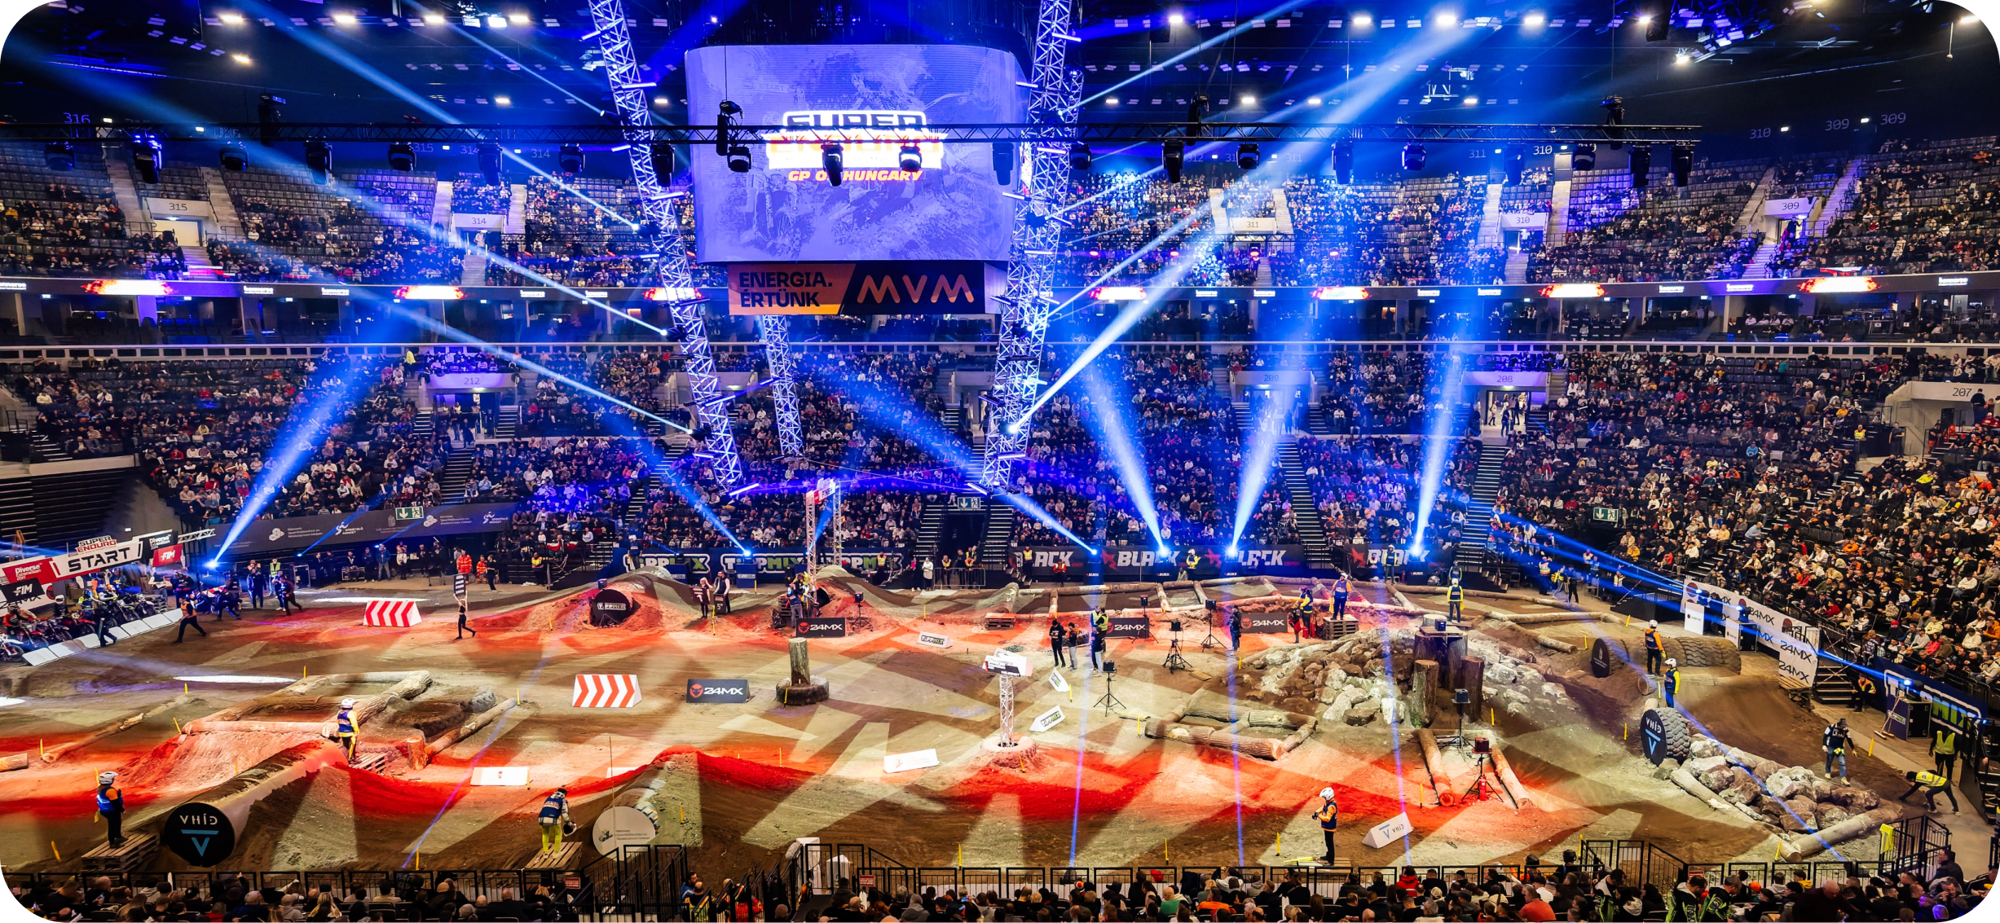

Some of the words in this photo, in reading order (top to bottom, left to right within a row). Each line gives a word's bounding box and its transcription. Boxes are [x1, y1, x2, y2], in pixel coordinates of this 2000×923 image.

[1825, 118, 1849, 131] 309
[1880, 112, 1906, 126] 309
[1750, 127, 1771, 139] 310
[1469, 149, 1486, 158] 311
[1533, 145, 1553, 156] 310
[788, 170, 811, 181] GP
[842, 170, 923, 182] HUNGARY
[169, 203, 188, 211] 315
[1782, 202, 1800, 210] 309
[471, 217, 487, 226] 314
[1246, 221, 1260, 229] 311
[1515, 216, 1530, 224] 310
[739, 271, 833, 288] ENERGIA.
[857, 274, 975, 304] MVM
[740, 287, 821, 308] ÉRTÜNK
[463, 377, 480, 386] 212
[1497, 375, 1513, 383] 208
[1952, 387, 1972, 397] 207
[77, 540, 117, 553] ENDURO
[67, 547, 130, 573] START
[13, 583, 33, 596] FIM
[810, 623, 843, 632] 24MX
[1252, 619, 1285, 627] 24MX
[1780, 640, 1813, 663] 24MX
[1778, 661, 1810, 685] 24MX
[703, 687, 744, 695] 24MX
[179, 813, 218, 825] VHÍD
